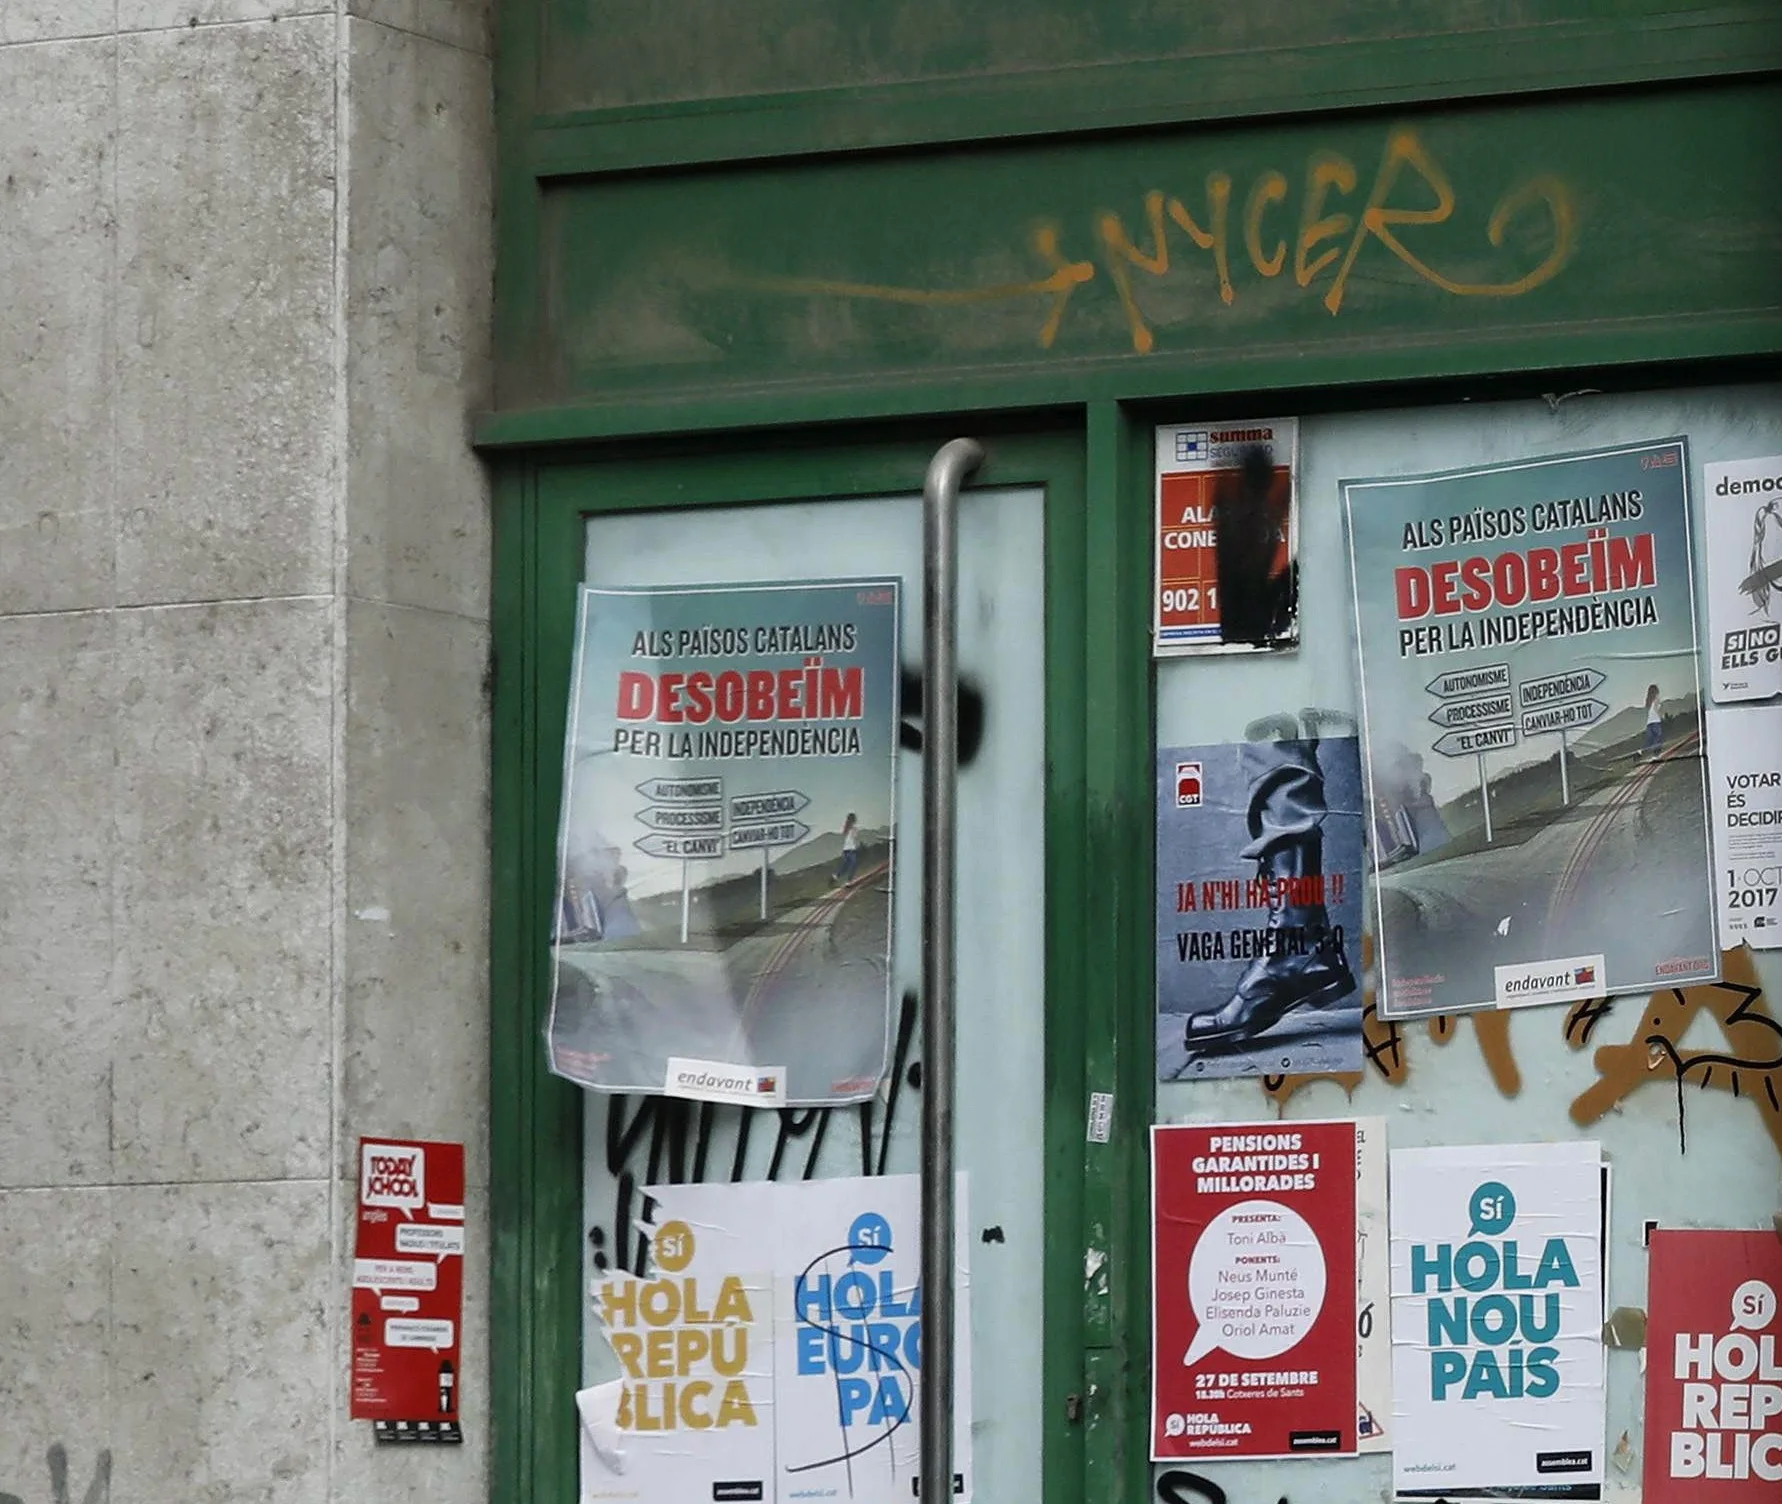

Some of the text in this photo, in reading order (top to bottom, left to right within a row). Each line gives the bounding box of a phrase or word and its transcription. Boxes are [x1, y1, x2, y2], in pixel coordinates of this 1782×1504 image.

[1210, 427, 1273, 444] summa
[1402, 490, 1644, 551] ALS PAÏSOS CATALANS
[1394, 528, 1657, 620] DESOBEÏM
[1162, 588, 1200, 612] 902
[1400, 596, 1659, 659] PER LA INDEPENDÈNCIA
[1751, 627, 1779, 647] NO
[632, 623, 857, 658] ALS PAÏSOS CATALANS
[1722, 651, 1758, 670] ELLS
[616, 656, 864, 725] DESOBEÏM
[1443, 668, 1508, 693] AUTONOMISME
[1523, 673, 1591, 704] INDEPENDÈNCIA
[1447, 699, 1510, 722] PROCESSISME
[1524, 704, 1593, 732] CANVIAR-HO TOT
[613, 721, 862, 760] PER LA INDEPENDÈNCIA
[1727, 773, 1781, 788] VOTAR
[1179, 794, 1200, 804] CGT
[1728, 791, 1745, 808] ÉS
[1177, 882, 1197, 913] JA
[1246, 877, 1273, 910] HA
[1277, 875, 1327, 908] PROU
[1729, 888, 1778, 909] 2017
[1177, 930, 1224, 962] VAGA
[1229, 926, 1308, 960] GENERAL
[1505, 970, 1571, 993] endavant
[677, 1070, 752, 1092] endavant
[1210, 1134, 1302, 1153] PENSIONS
[371, 1155, 416, 1177] TODAY
[1192, 1154, 1320, 1173] GARANTIDES I
[1197, 1174, 1315, 1193] MILLORADES
[1232, 1214, 1281, 1223] PRESENTA:
[1479, 1195, 1504, 1221] Sí
[1228, 1231, 1287, 1245] Toni Albà
[1218, 1268, 1298, 1282] Neus Munté
[1411, 1238, 1580, 1295] HOLA
[602, 1276, 754, 1327] HOLA
[1211, 1287, 1305, 1303] Josep Ginesta
[1206, 1306, 1261, 1320] Elisenda
[1426, 1292, 1561, 1347] NOU
[1222, 1323, 1295, 1337] Oriol Amat
[1196, 1371, 1318, 1387] 27 DE SETEMBRE
[1431, 1340, 1560, 1401] PAÍS
[839, 1375, 912, 1427] PA
[1227, 1387, 1304, 1399] Cotxeres de Sants
[1187, 1414, 1219, 1424] HOLA
